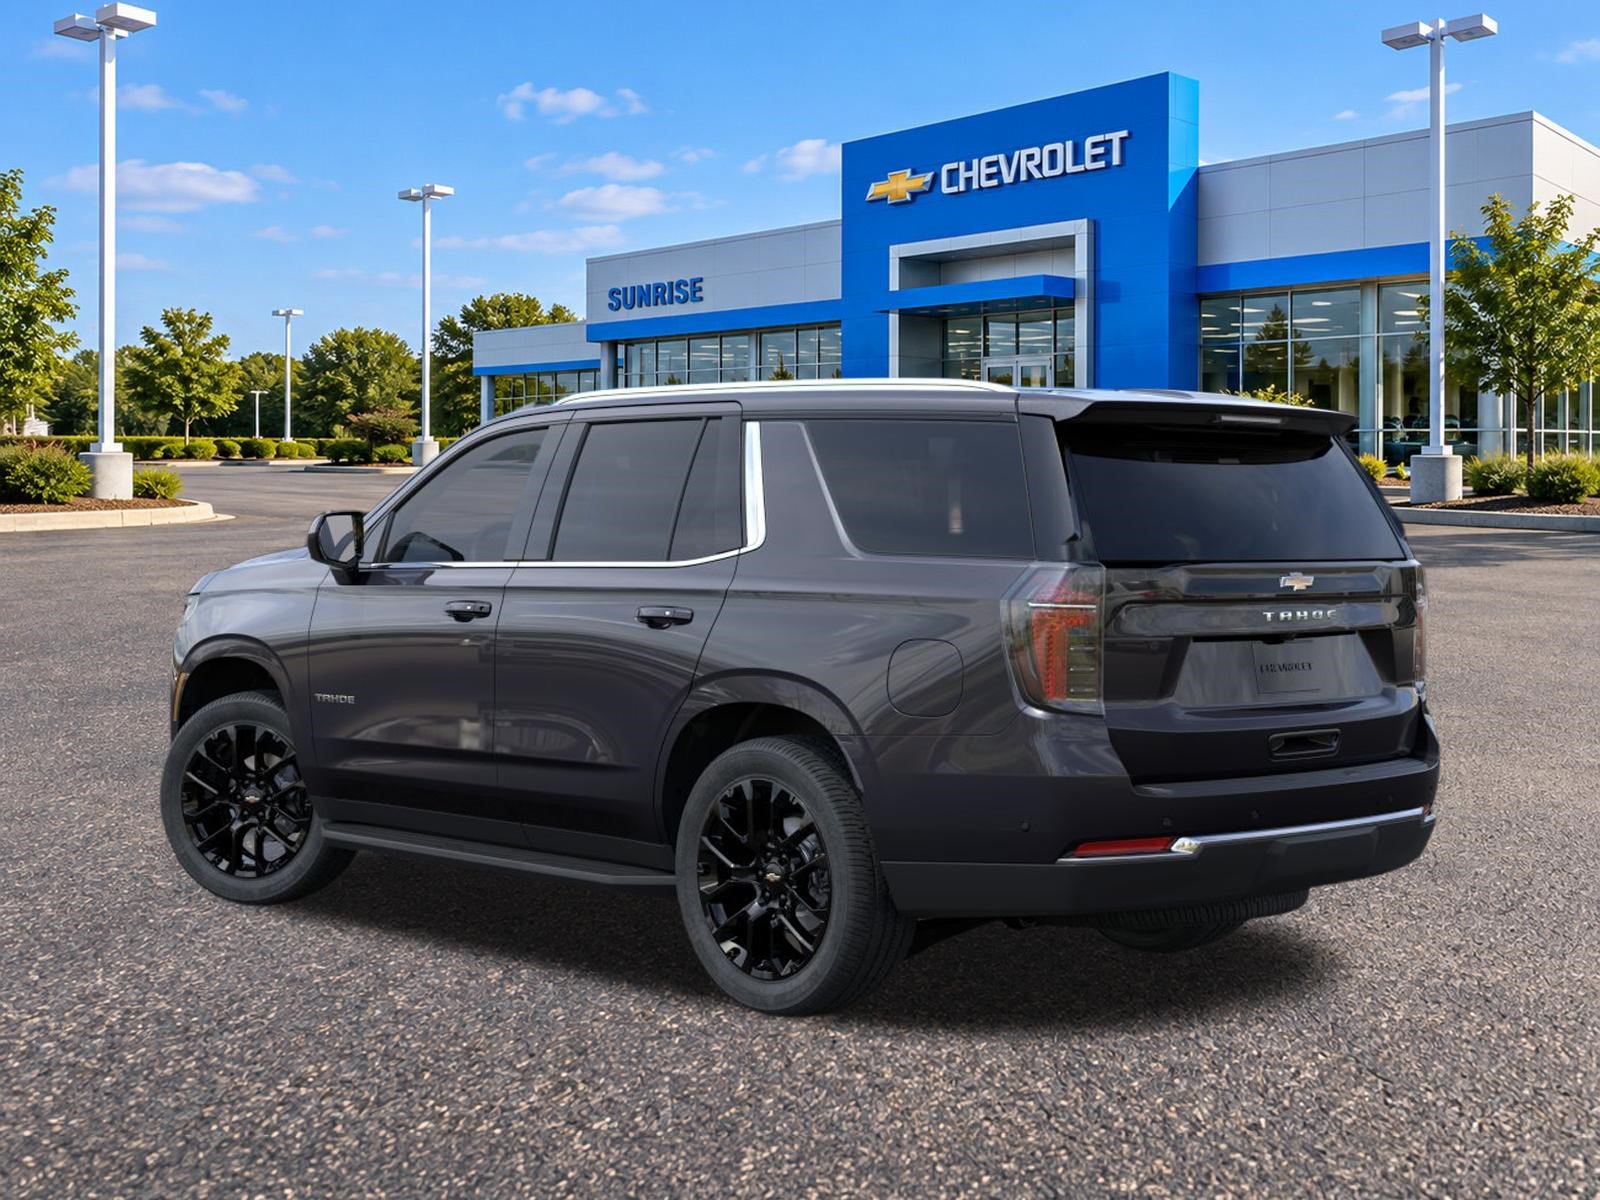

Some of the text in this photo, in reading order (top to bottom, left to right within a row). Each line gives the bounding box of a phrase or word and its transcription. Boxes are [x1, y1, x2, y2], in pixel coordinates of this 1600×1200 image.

[941, 130, 1129, 194] CHEVROLET
[608, 277, 704, 312] SUNRISE
[1263, 609, 1337, 622] TAHOE
[314, 692, 355, 704] TAHOE
